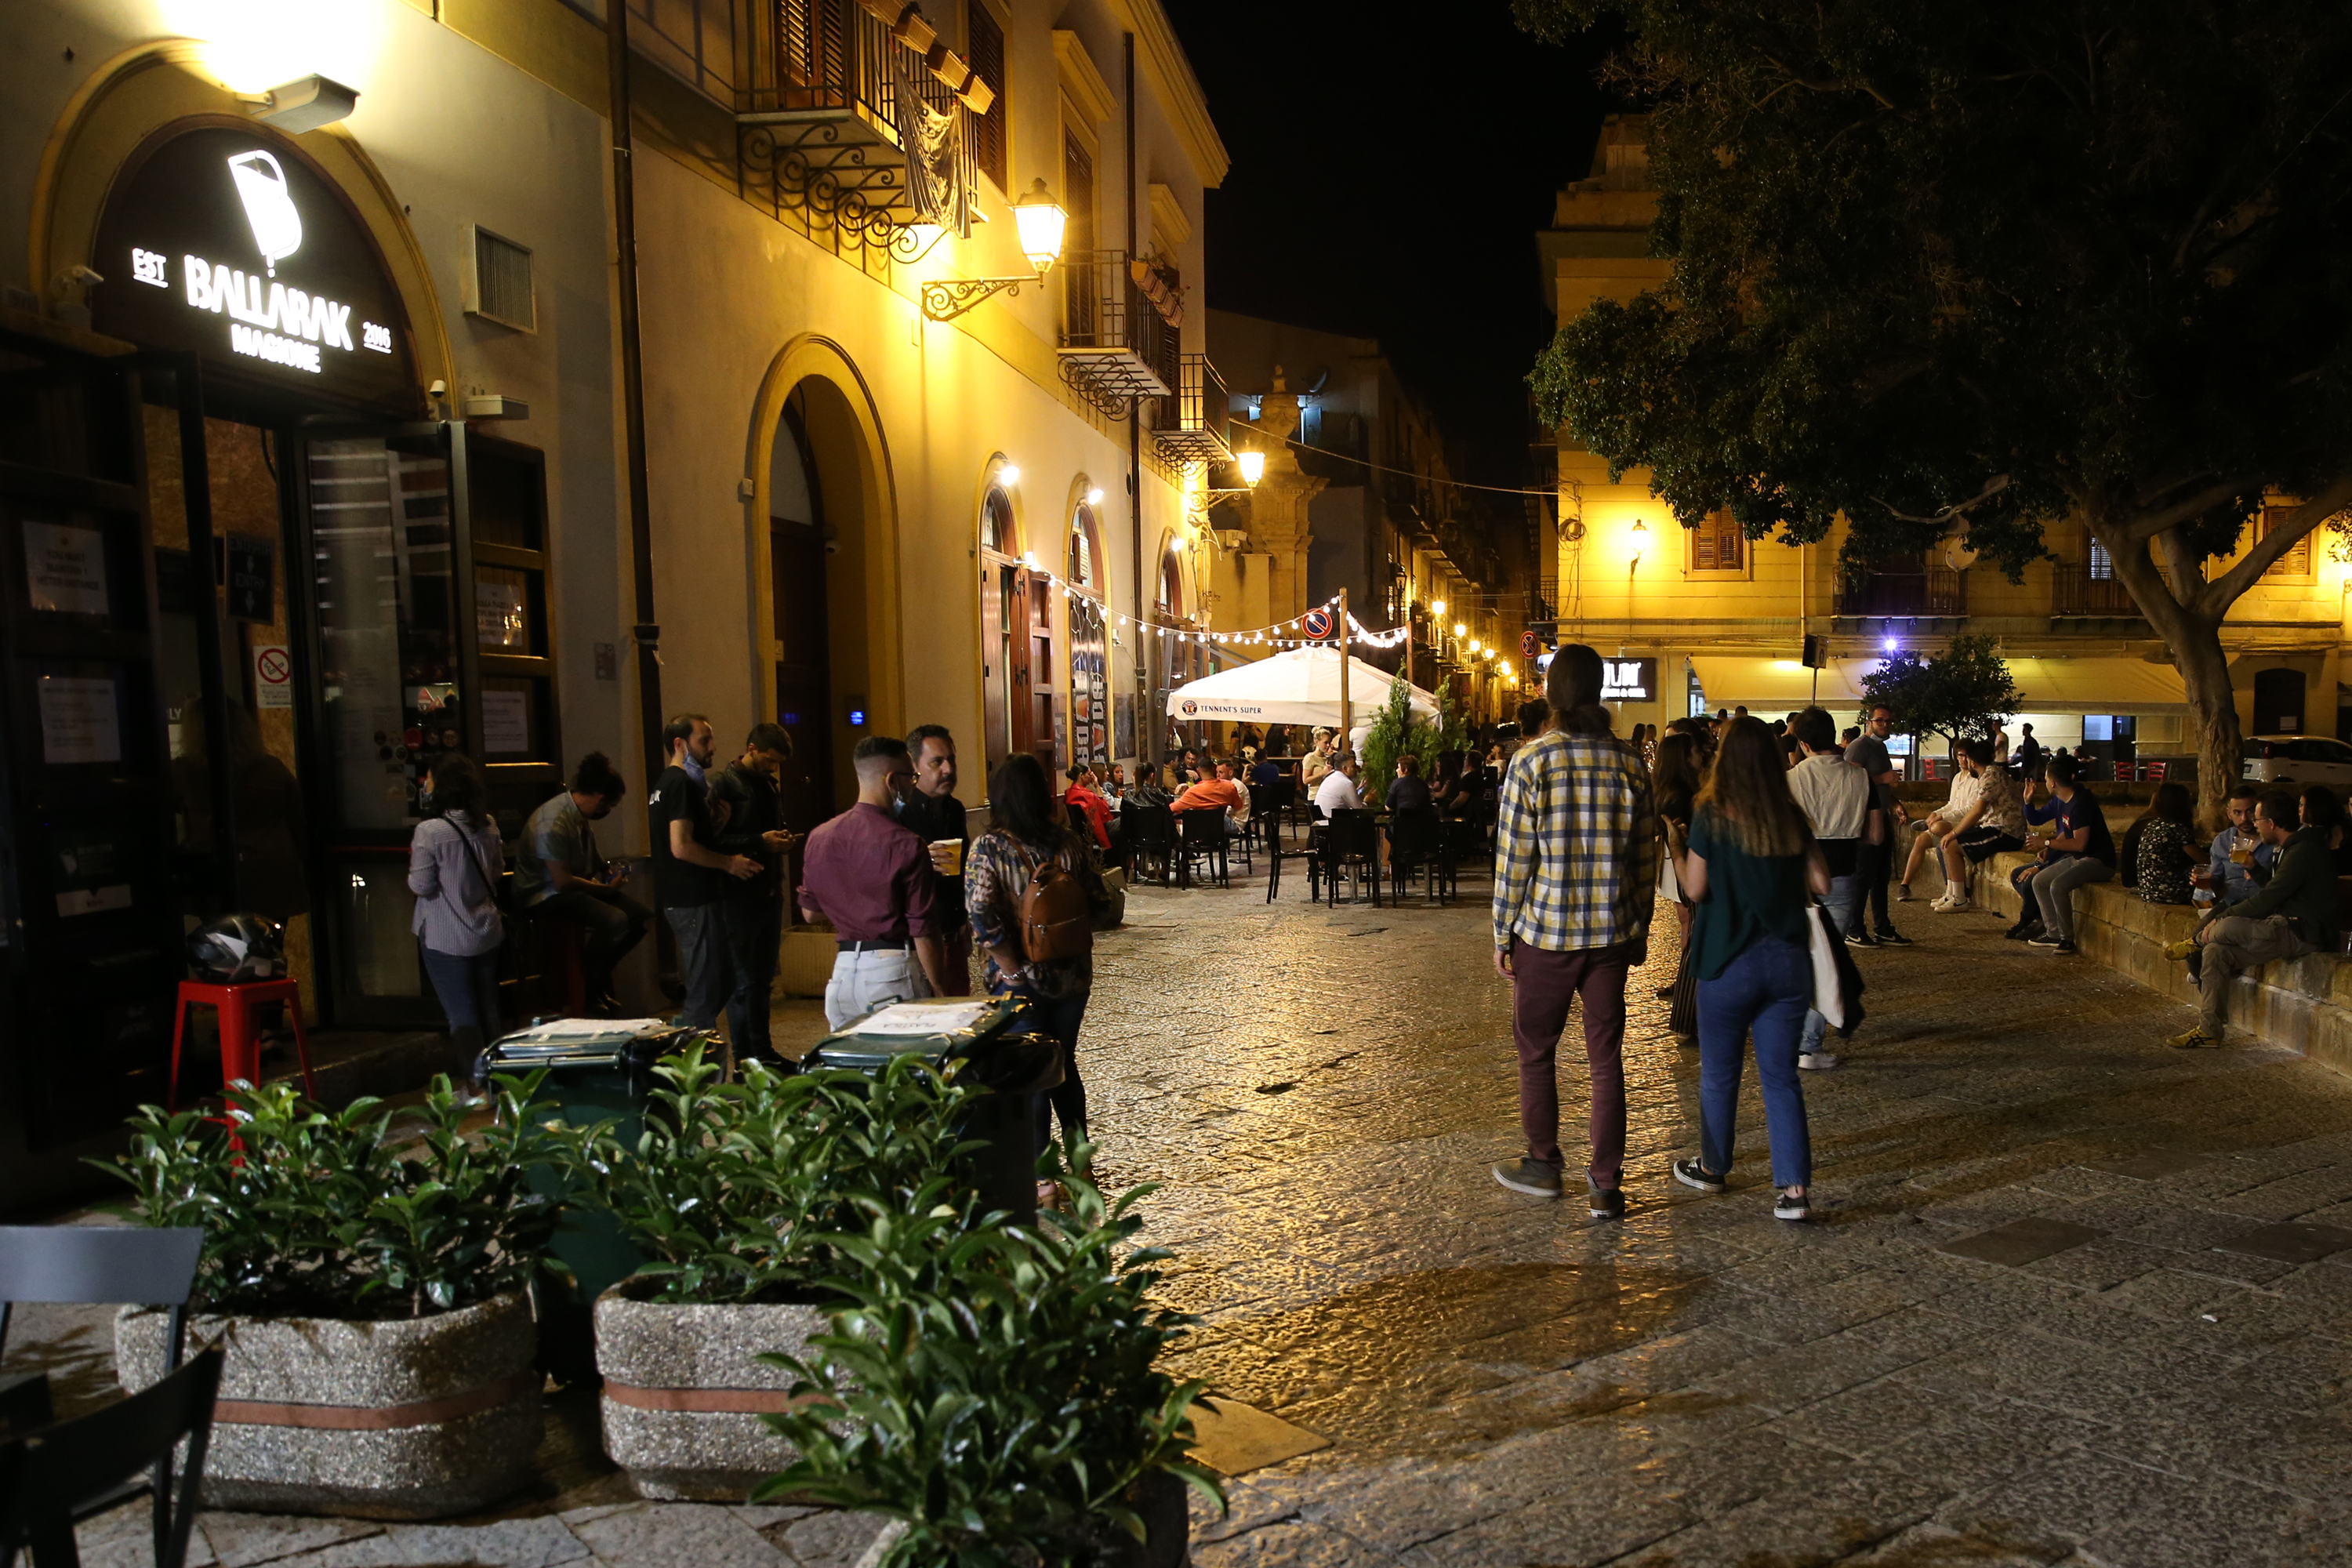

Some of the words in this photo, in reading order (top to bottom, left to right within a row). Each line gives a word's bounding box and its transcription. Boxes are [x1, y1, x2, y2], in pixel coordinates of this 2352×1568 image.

[132, 248, 167, 281] EST
[184, 255, 354, 351] BALLARAK
[231, 324, 321, 373] MAGIONE
[363, 321, 391, 348] 2016
[166, 708, 182, 720] LY
[1200, 705, 1238, 713] TENNENT'S
